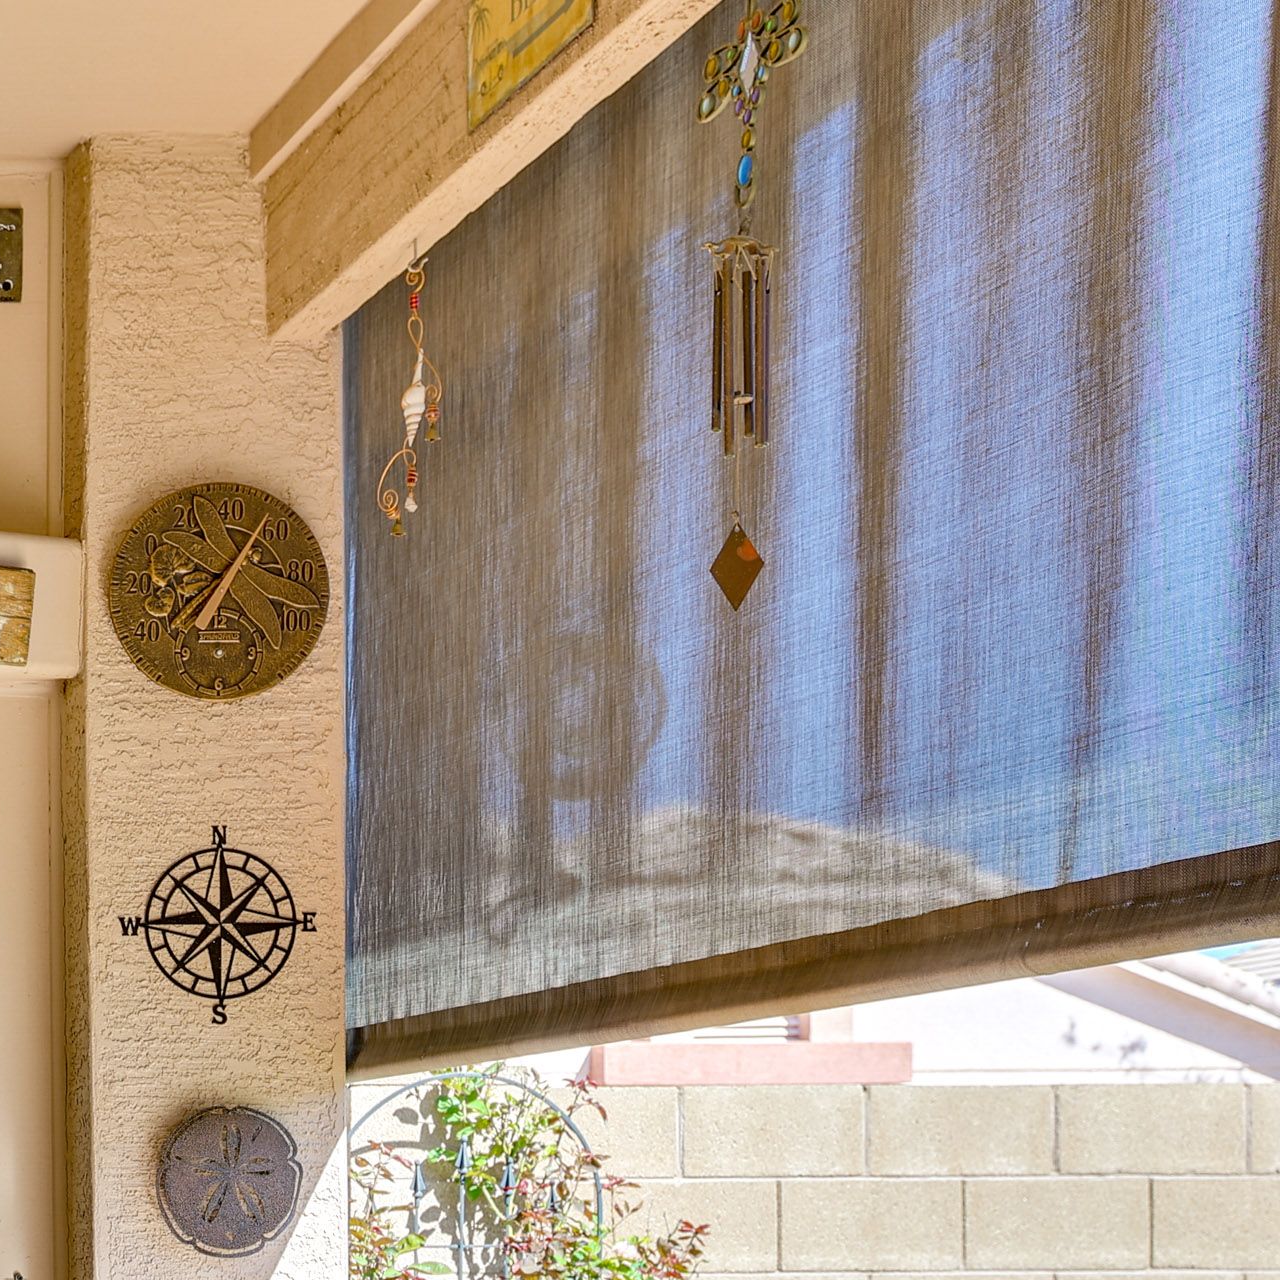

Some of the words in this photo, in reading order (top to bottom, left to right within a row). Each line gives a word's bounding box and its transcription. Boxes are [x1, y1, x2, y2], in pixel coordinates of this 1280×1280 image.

[218, 498, 244, 522] 40
[262, 517, 289, 542] 60
[288, 559, 314, 583] 80
[125, 571, 153, 596] 20
[132, 618, 161, 643] 40
[213, 615, 227, 629] 12
[181, 647, 191, 661] 9
[247, 647, 257, 660] 3
[213, 677, 224, 690] 6
[211, 825, 228, 845] N
[118, 916, 142, 937] W
[301, 911, 318, 932] E
[211, 1004, 228, 1025] S
